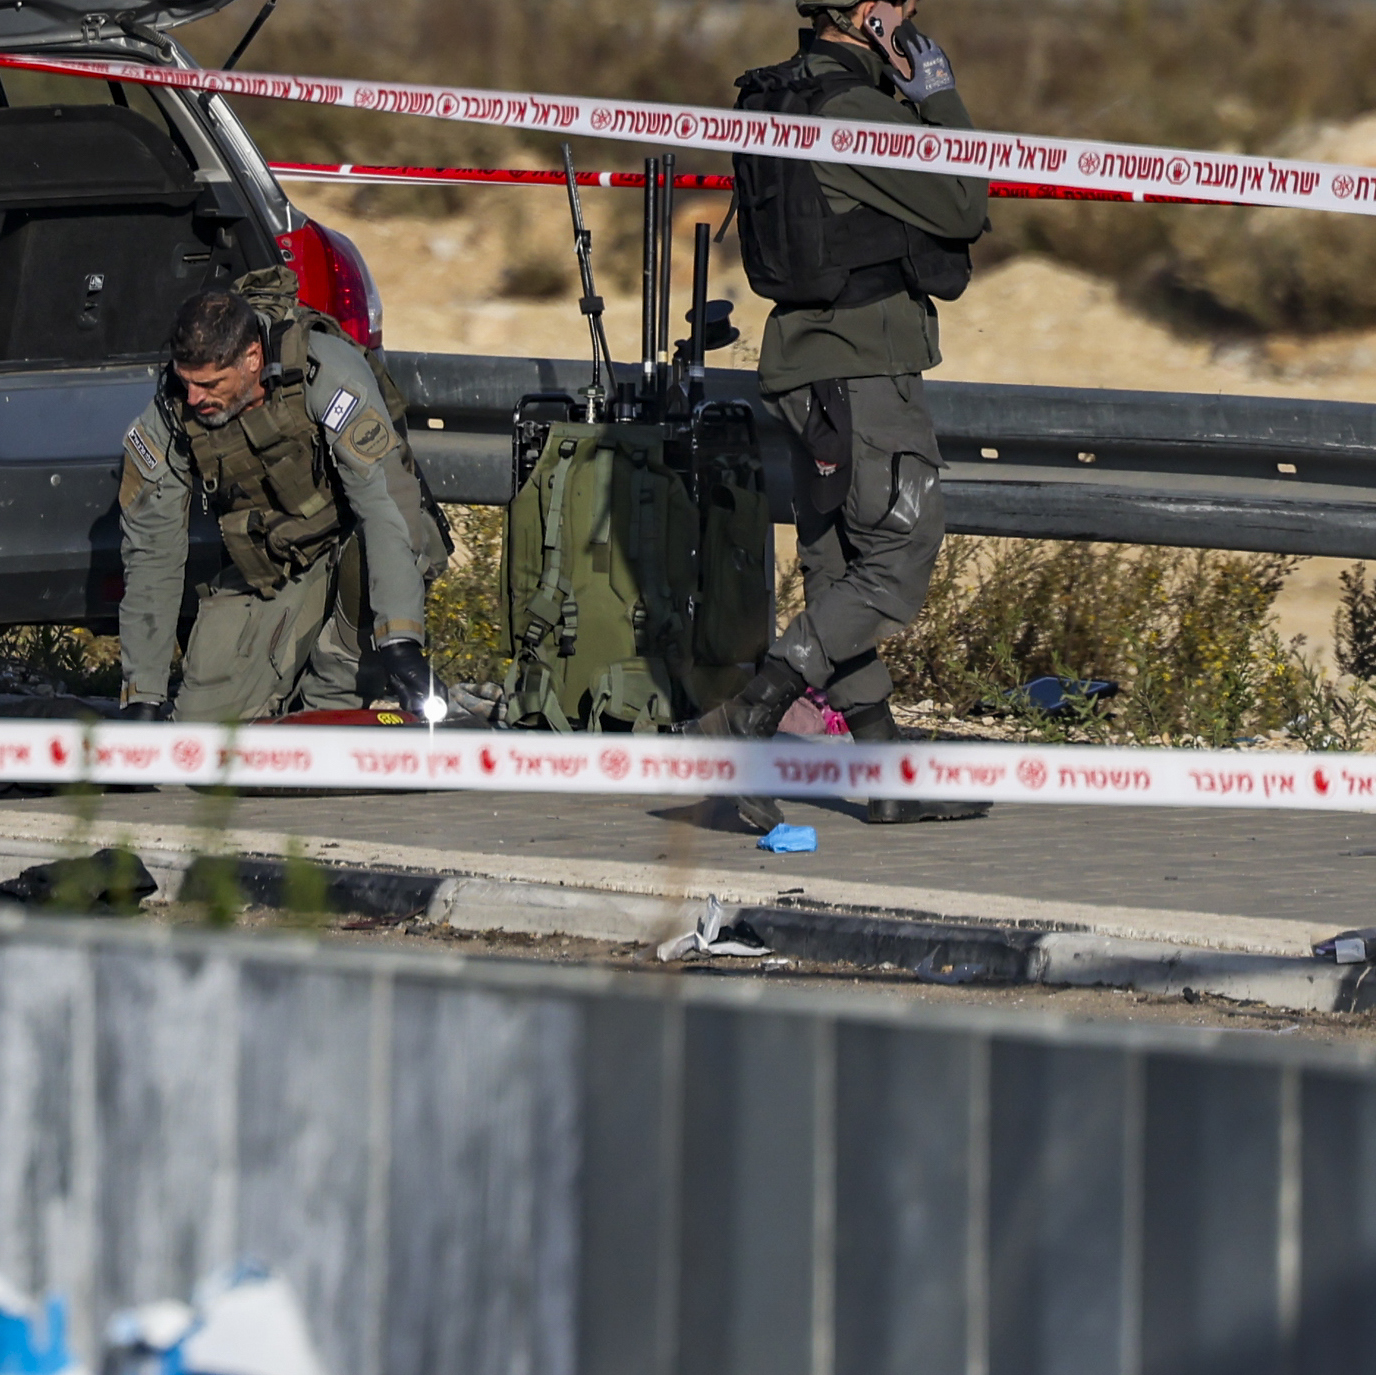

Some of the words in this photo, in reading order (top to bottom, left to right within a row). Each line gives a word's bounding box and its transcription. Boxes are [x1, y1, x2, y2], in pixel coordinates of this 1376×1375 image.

[374, 89, 434, 114] משטרת
[462, 95, 503, 121] מעבר
[501, 99, 526, 125] אין
[529, 95, 579, 127] ישראל
[611, 108, 672, 136] משטרת
[700, 116, 742, 141] מעבר
[742, 120, 765, 148] אין
[770, 118, 820, 149] ישראל
[852, 130, 915, 158] משטרת
[944, 138, 987, 165] מעבר
[988, 143, 1013, 171] אין
[1016, 139, 1069, 172] ישראל
[1100, 151, 1164, 181] משטרת
[1193, 161, 1238, 188] מעבר
[1268, 161, 1320, 195] ישראל
[1240, 166, 1264, 195] אין
